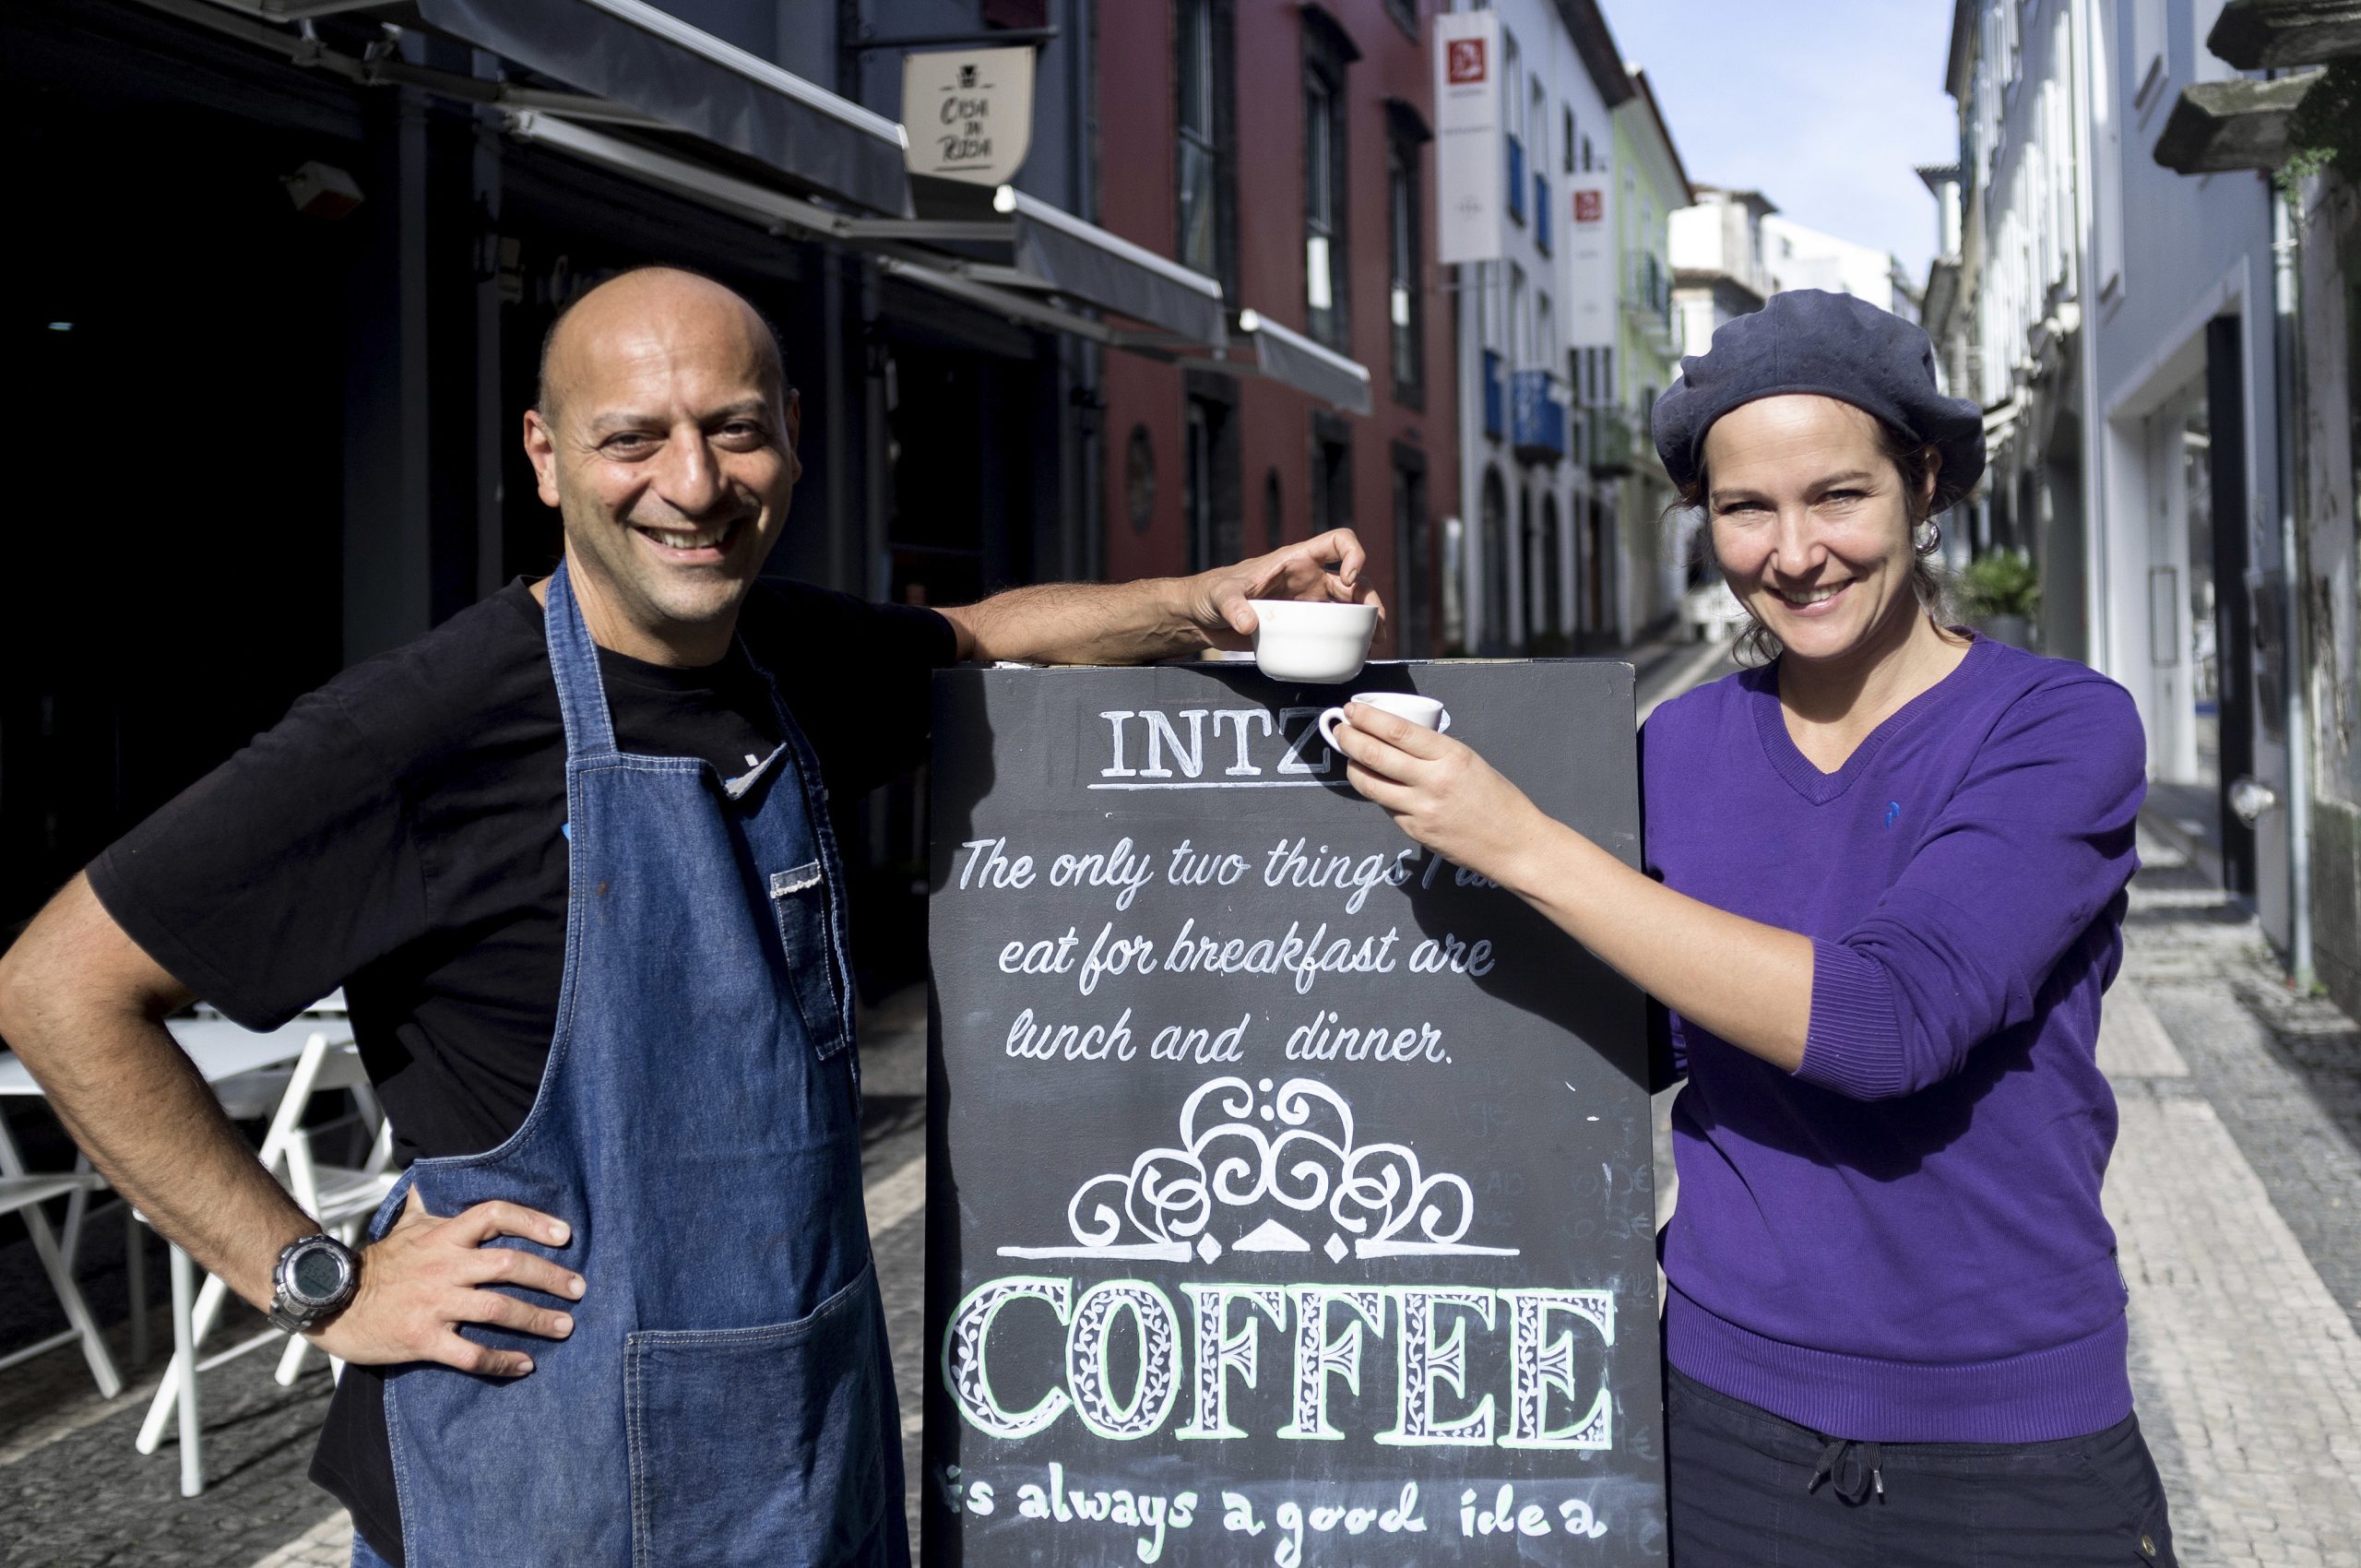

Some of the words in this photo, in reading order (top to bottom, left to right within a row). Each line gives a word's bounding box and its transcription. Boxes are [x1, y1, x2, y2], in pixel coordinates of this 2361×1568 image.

[959, 837, 1036, 890] The
[1050, 837, 1154, 911] only
[1169, 838, 1252, 886] two
[1264, 836, 1413, 915] things
[999, 927, 1078, 975] eat
[1079, 921, 1157, 996] for
[1164, 918, 1399, 994] breakfast
[1408, 936, 1496, 977] are
[1006, 1007, 1136, 1062] lunch
[1151, 1013, 1251, 1064] and
[1286, 1010, 1453, 1063] dinner.
[942, 1275, 1614, 1451] COFFEE
[1017, 1463, 1197, 1564] always
[1222, 1491, 1265, 1537] a
[1275, 1482, 1427, 1568] good
[1461, 1483, 1608, 1538] idea
